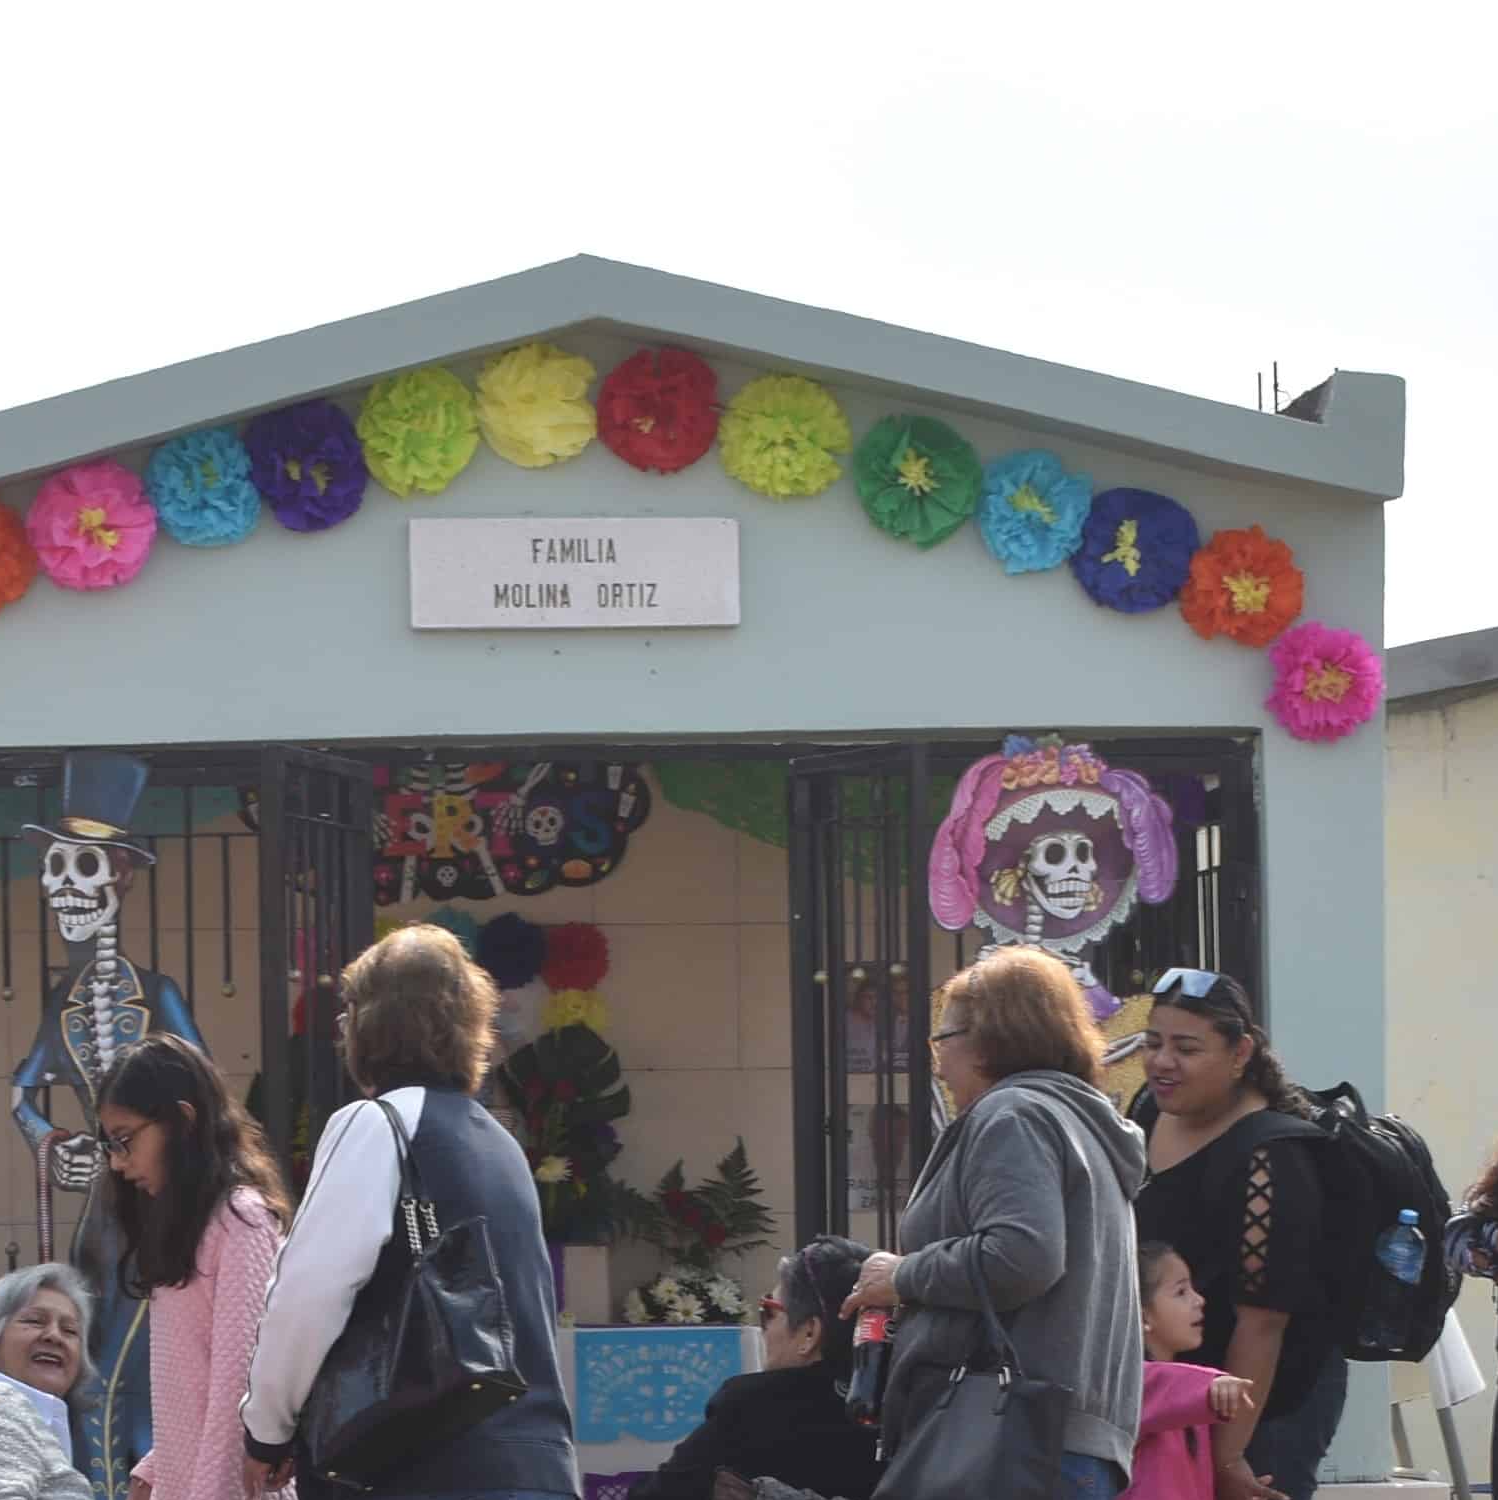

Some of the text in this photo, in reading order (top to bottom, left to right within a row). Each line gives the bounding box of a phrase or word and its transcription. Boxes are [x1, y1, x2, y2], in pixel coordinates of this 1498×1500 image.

[531, 538, 617, 564] FAMILIA
[494, 583, 659, 609] MOLINA ORTIZ
